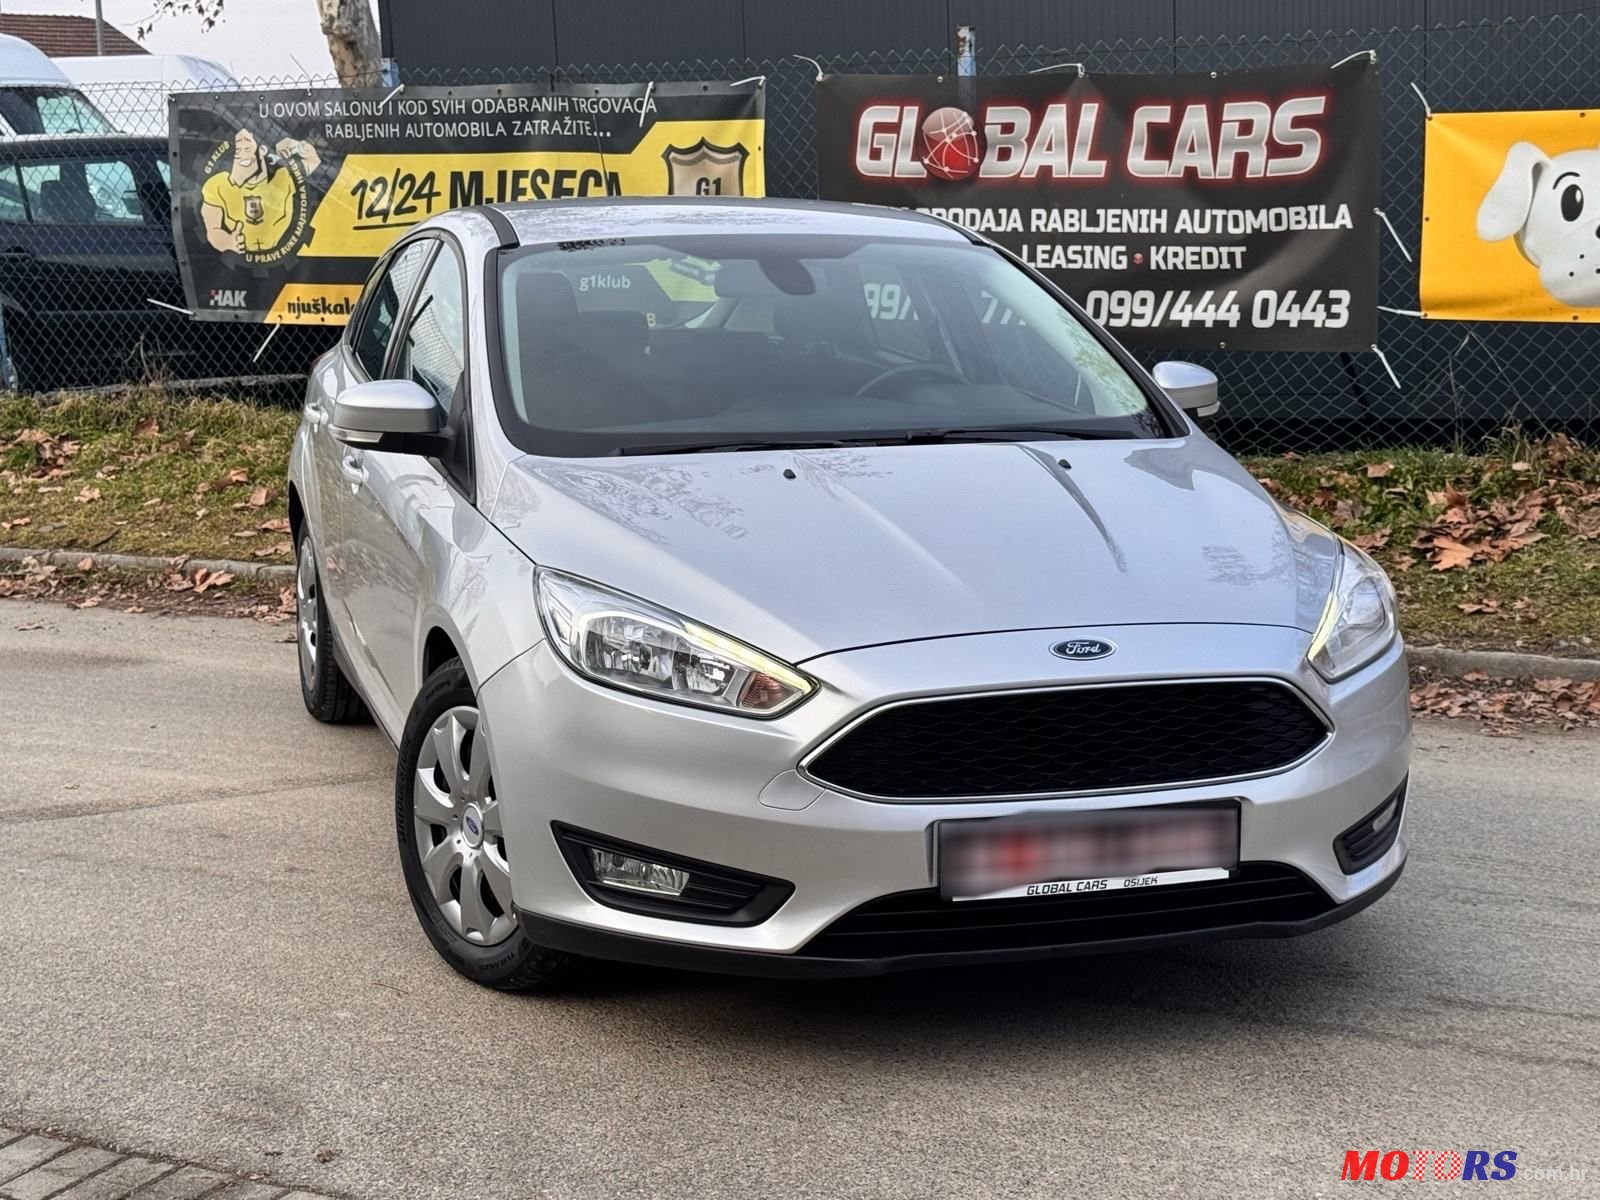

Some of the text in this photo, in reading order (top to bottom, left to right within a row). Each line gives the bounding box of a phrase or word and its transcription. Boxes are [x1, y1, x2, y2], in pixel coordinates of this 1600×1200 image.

[259, 97, 657, 118] U OVOM SALONU I KOD SVIH ODABRANIH TRGOVACA
[325, 116, 611, 141] RABLJENIH AUTOMOBILA ZATRAŽITE...
[855, 96, 1326, 181] GLOBAL CARS
[350, 168, 442, 223] 12/24
[449, 168, 622, 209] MJESECA
[696, 176, 722, 196] G1
[1031, 208, 1167, 233] RABLJENIH
[1174, 204, 1353, 234] AUTOMOBILA
[1022, 245, 1247, 270] LEASING KREDIT
[579, 275, 631, 291] g1klub
[209, 289, 247, 307] HAK
[1086, 290, 1351, 328] 099/444 0443
[1066, 641, 1101, 655] Ford
[1027, 876, 1158, 896] GLOBAL CARS OSIJEK
